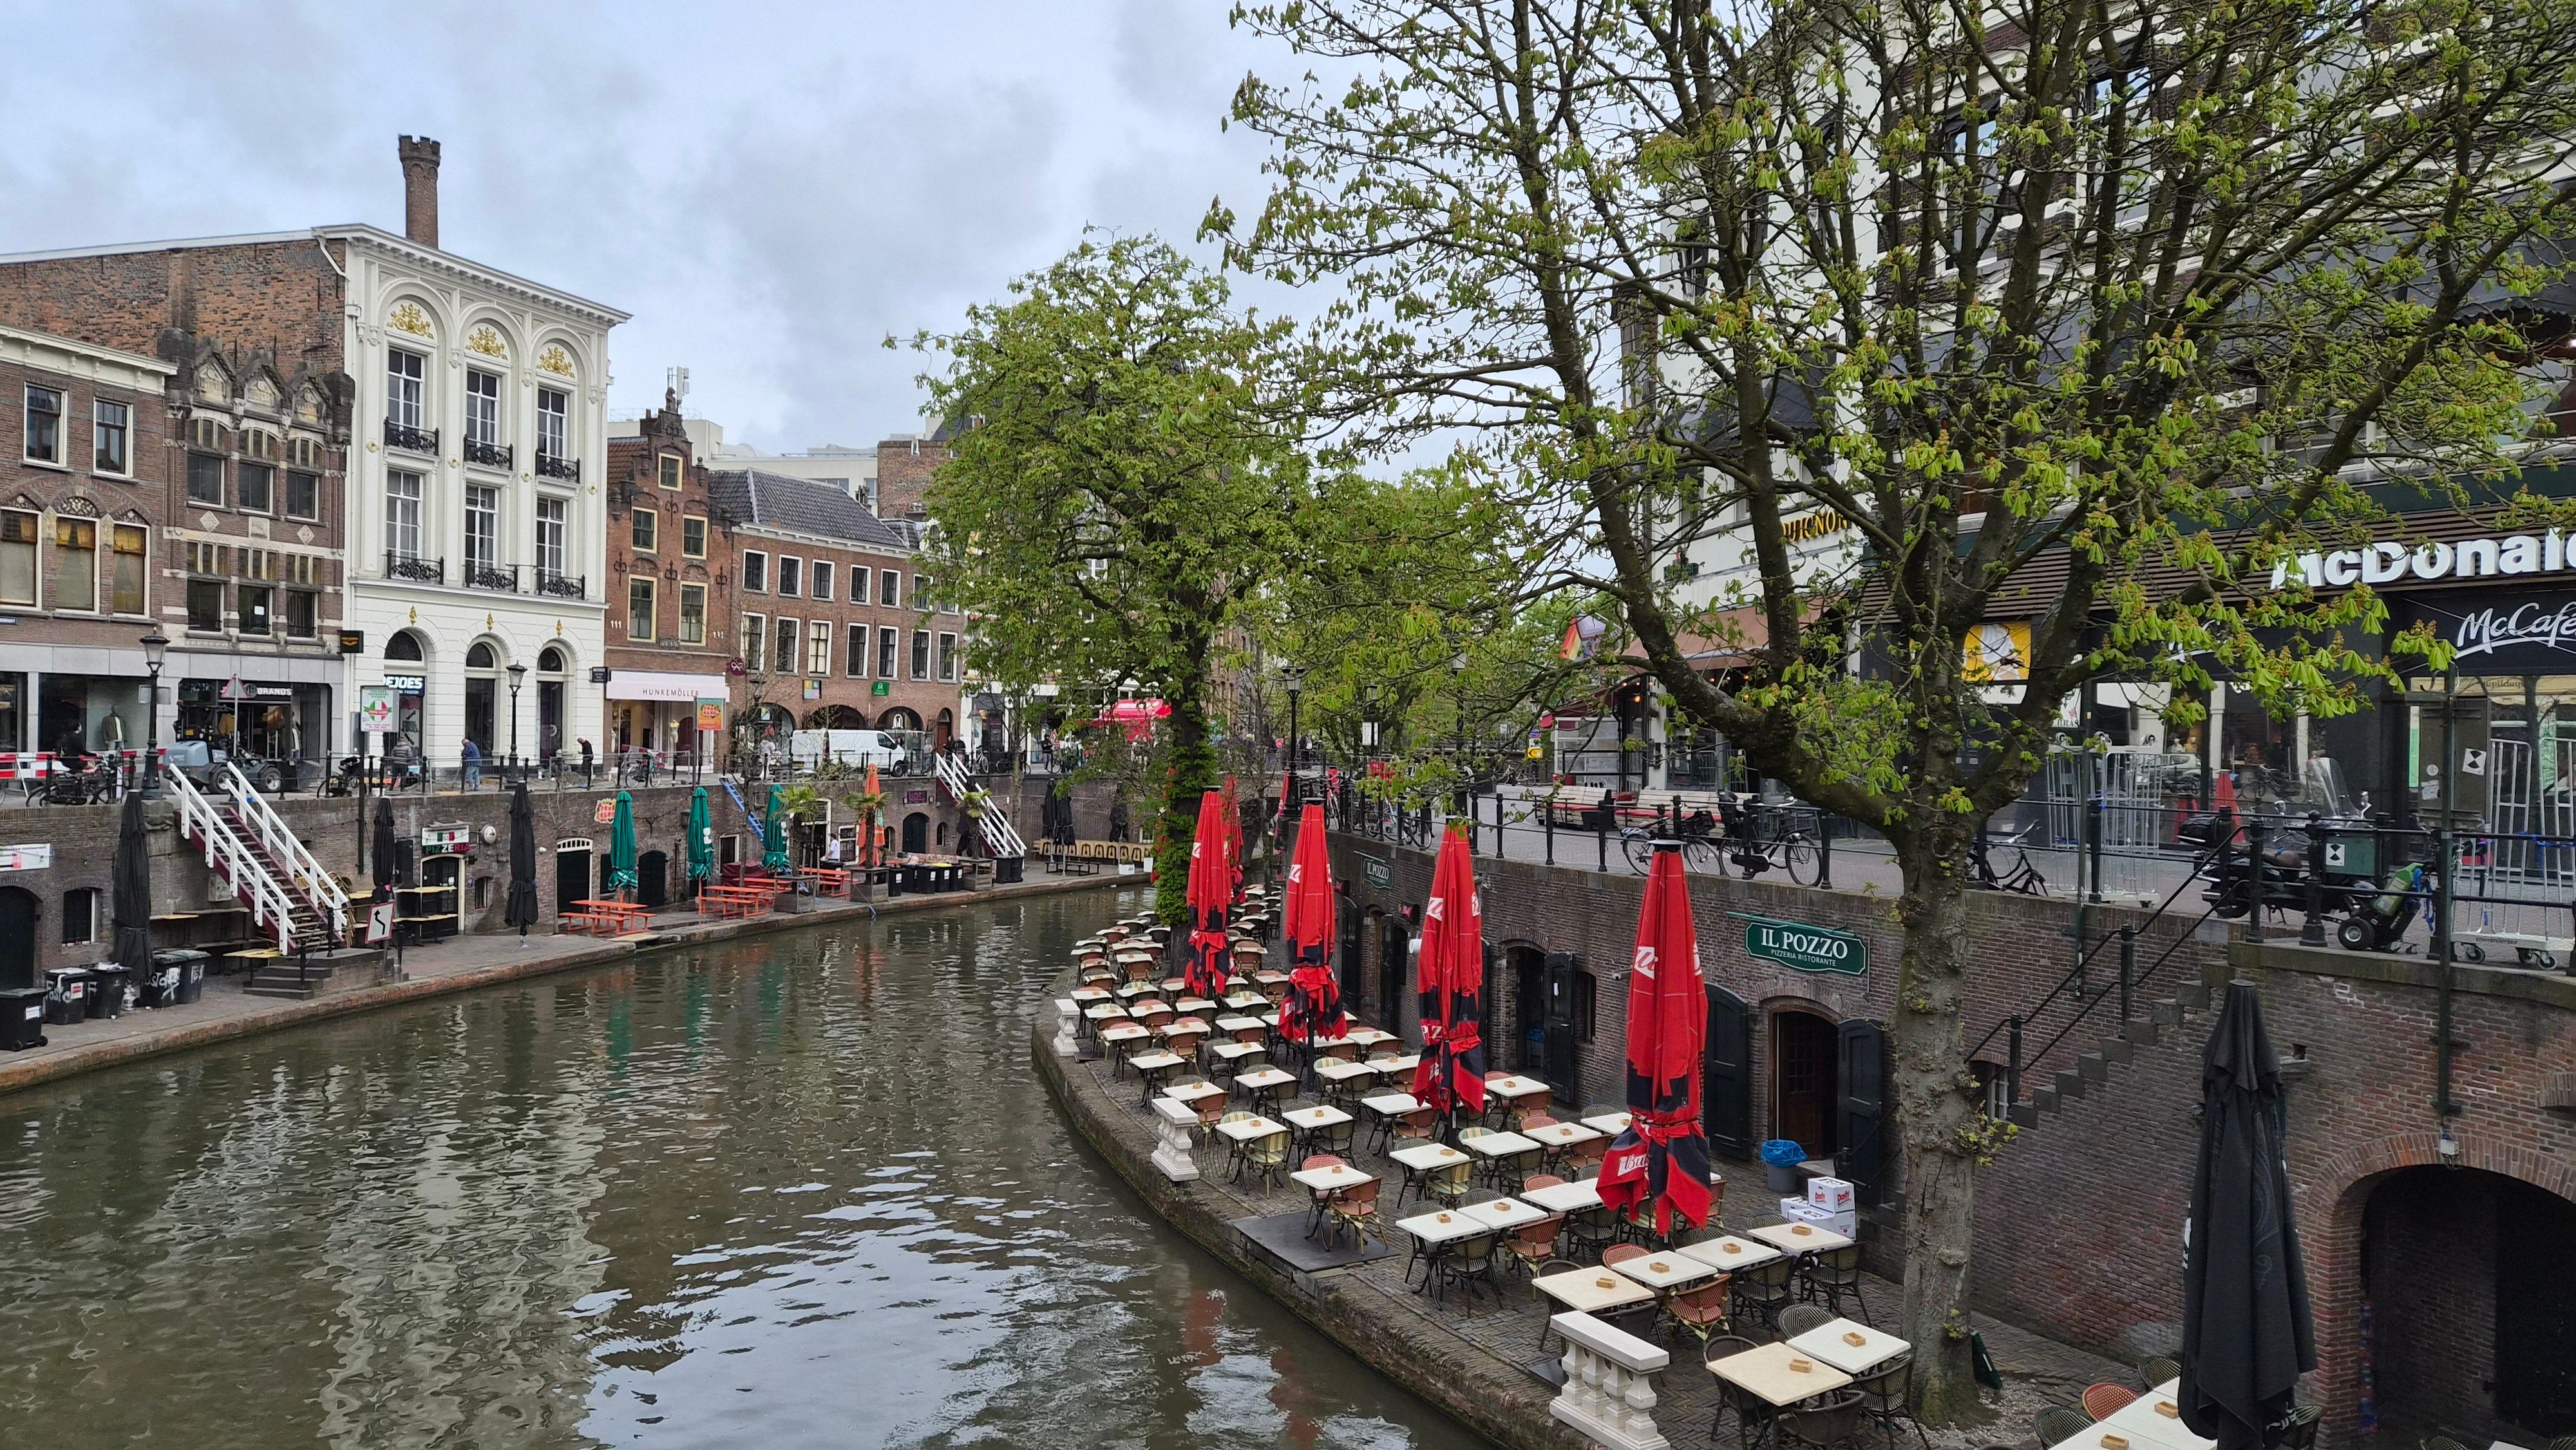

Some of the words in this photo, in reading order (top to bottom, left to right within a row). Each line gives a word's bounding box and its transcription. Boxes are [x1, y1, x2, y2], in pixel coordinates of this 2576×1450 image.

[2270, 527, 2576, 589] McDonal
[643, 687, 699, 697] HUNKEMÖLLER
[426, 843, 471, 853] PIZZERIA
[1372, 863, 1389, 880] POZZO
[1761, 928, 1779, 948] IL
[1782, 931, 1848, 959] POZZO
[1771, 949, 1797, 959] PIZZERIA
[1798, 954, 1837, 966] RISTORANTE
